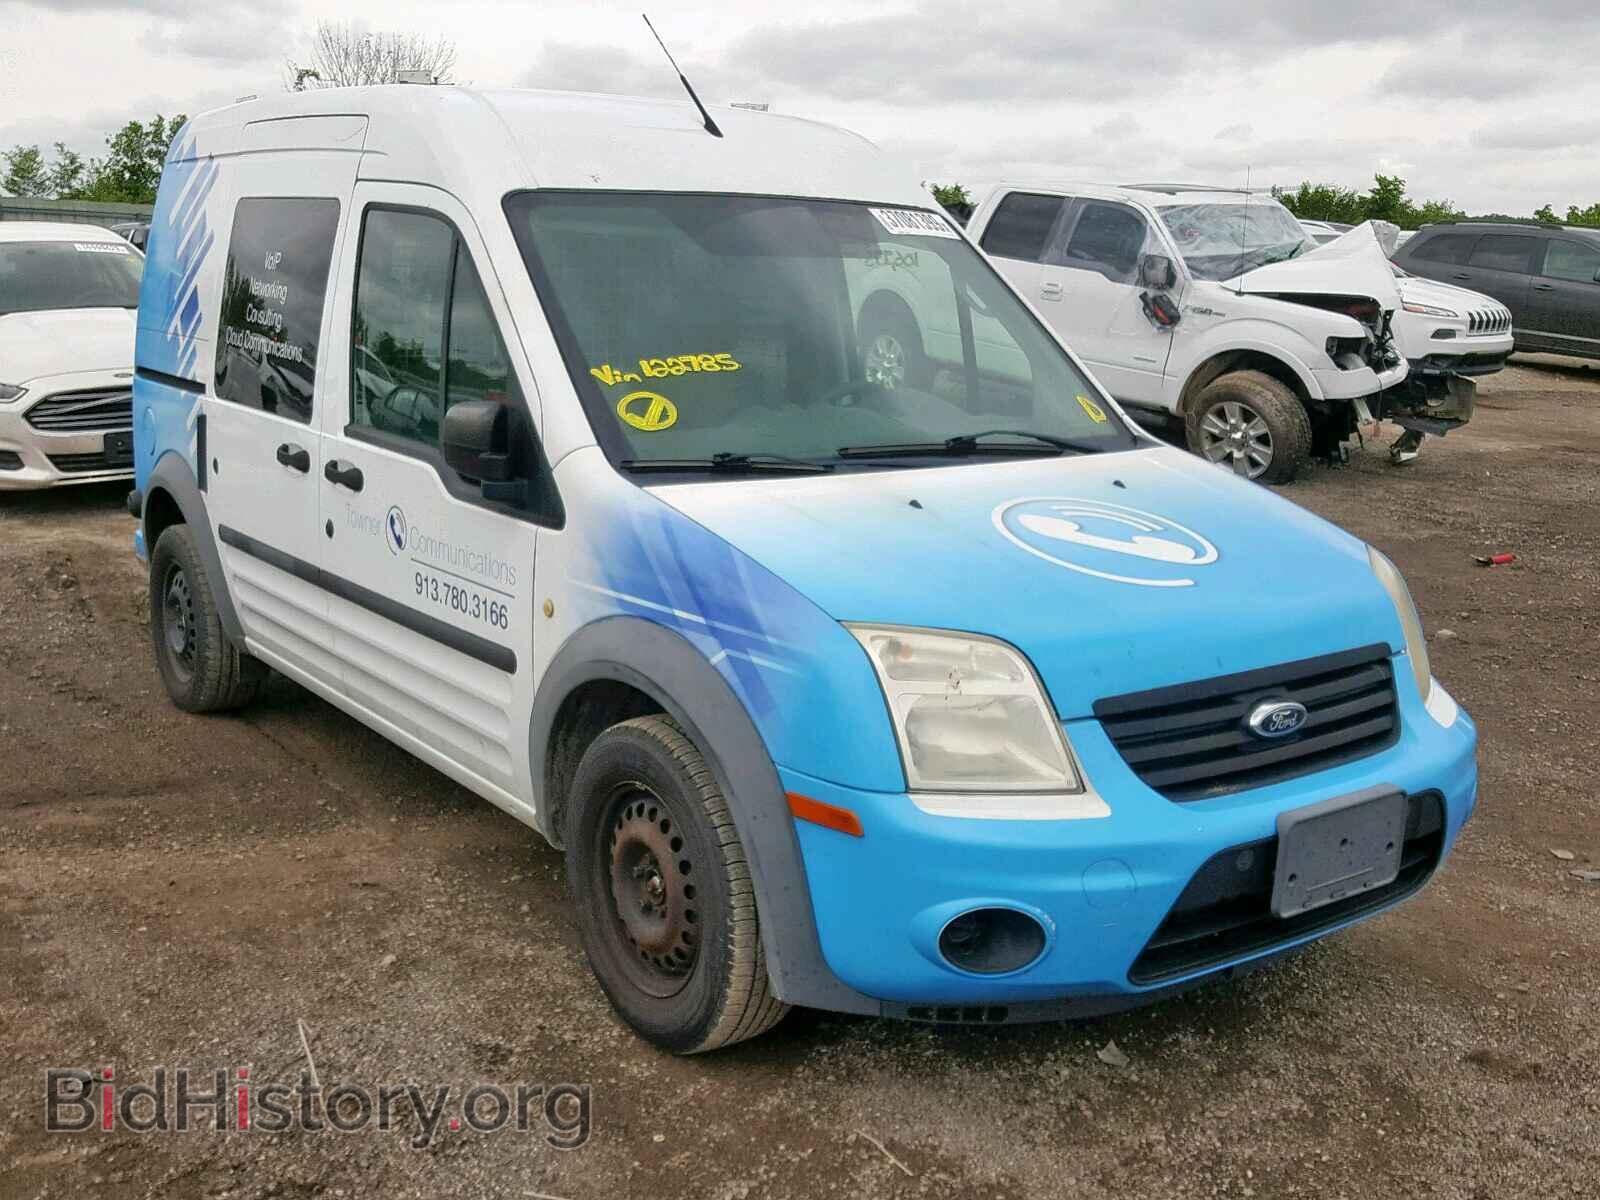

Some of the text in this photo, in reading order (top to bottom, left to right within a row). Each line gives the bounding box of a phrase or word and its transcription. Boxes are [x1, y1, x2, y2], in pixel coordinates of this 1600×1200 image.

[264, 251, 282, 270] VoIP
[249, 276, 288, 305] Networking
[246, 303, 283, 333] Consulting
[225, 326, 303, 362] Cloud Communications
[591, 364, 642, 386] Vin
[409, 526, 517, 586] Communications
[415, 571, 508, 631] 913.780.3166
[1270, 709, 1298, 731] Ford
